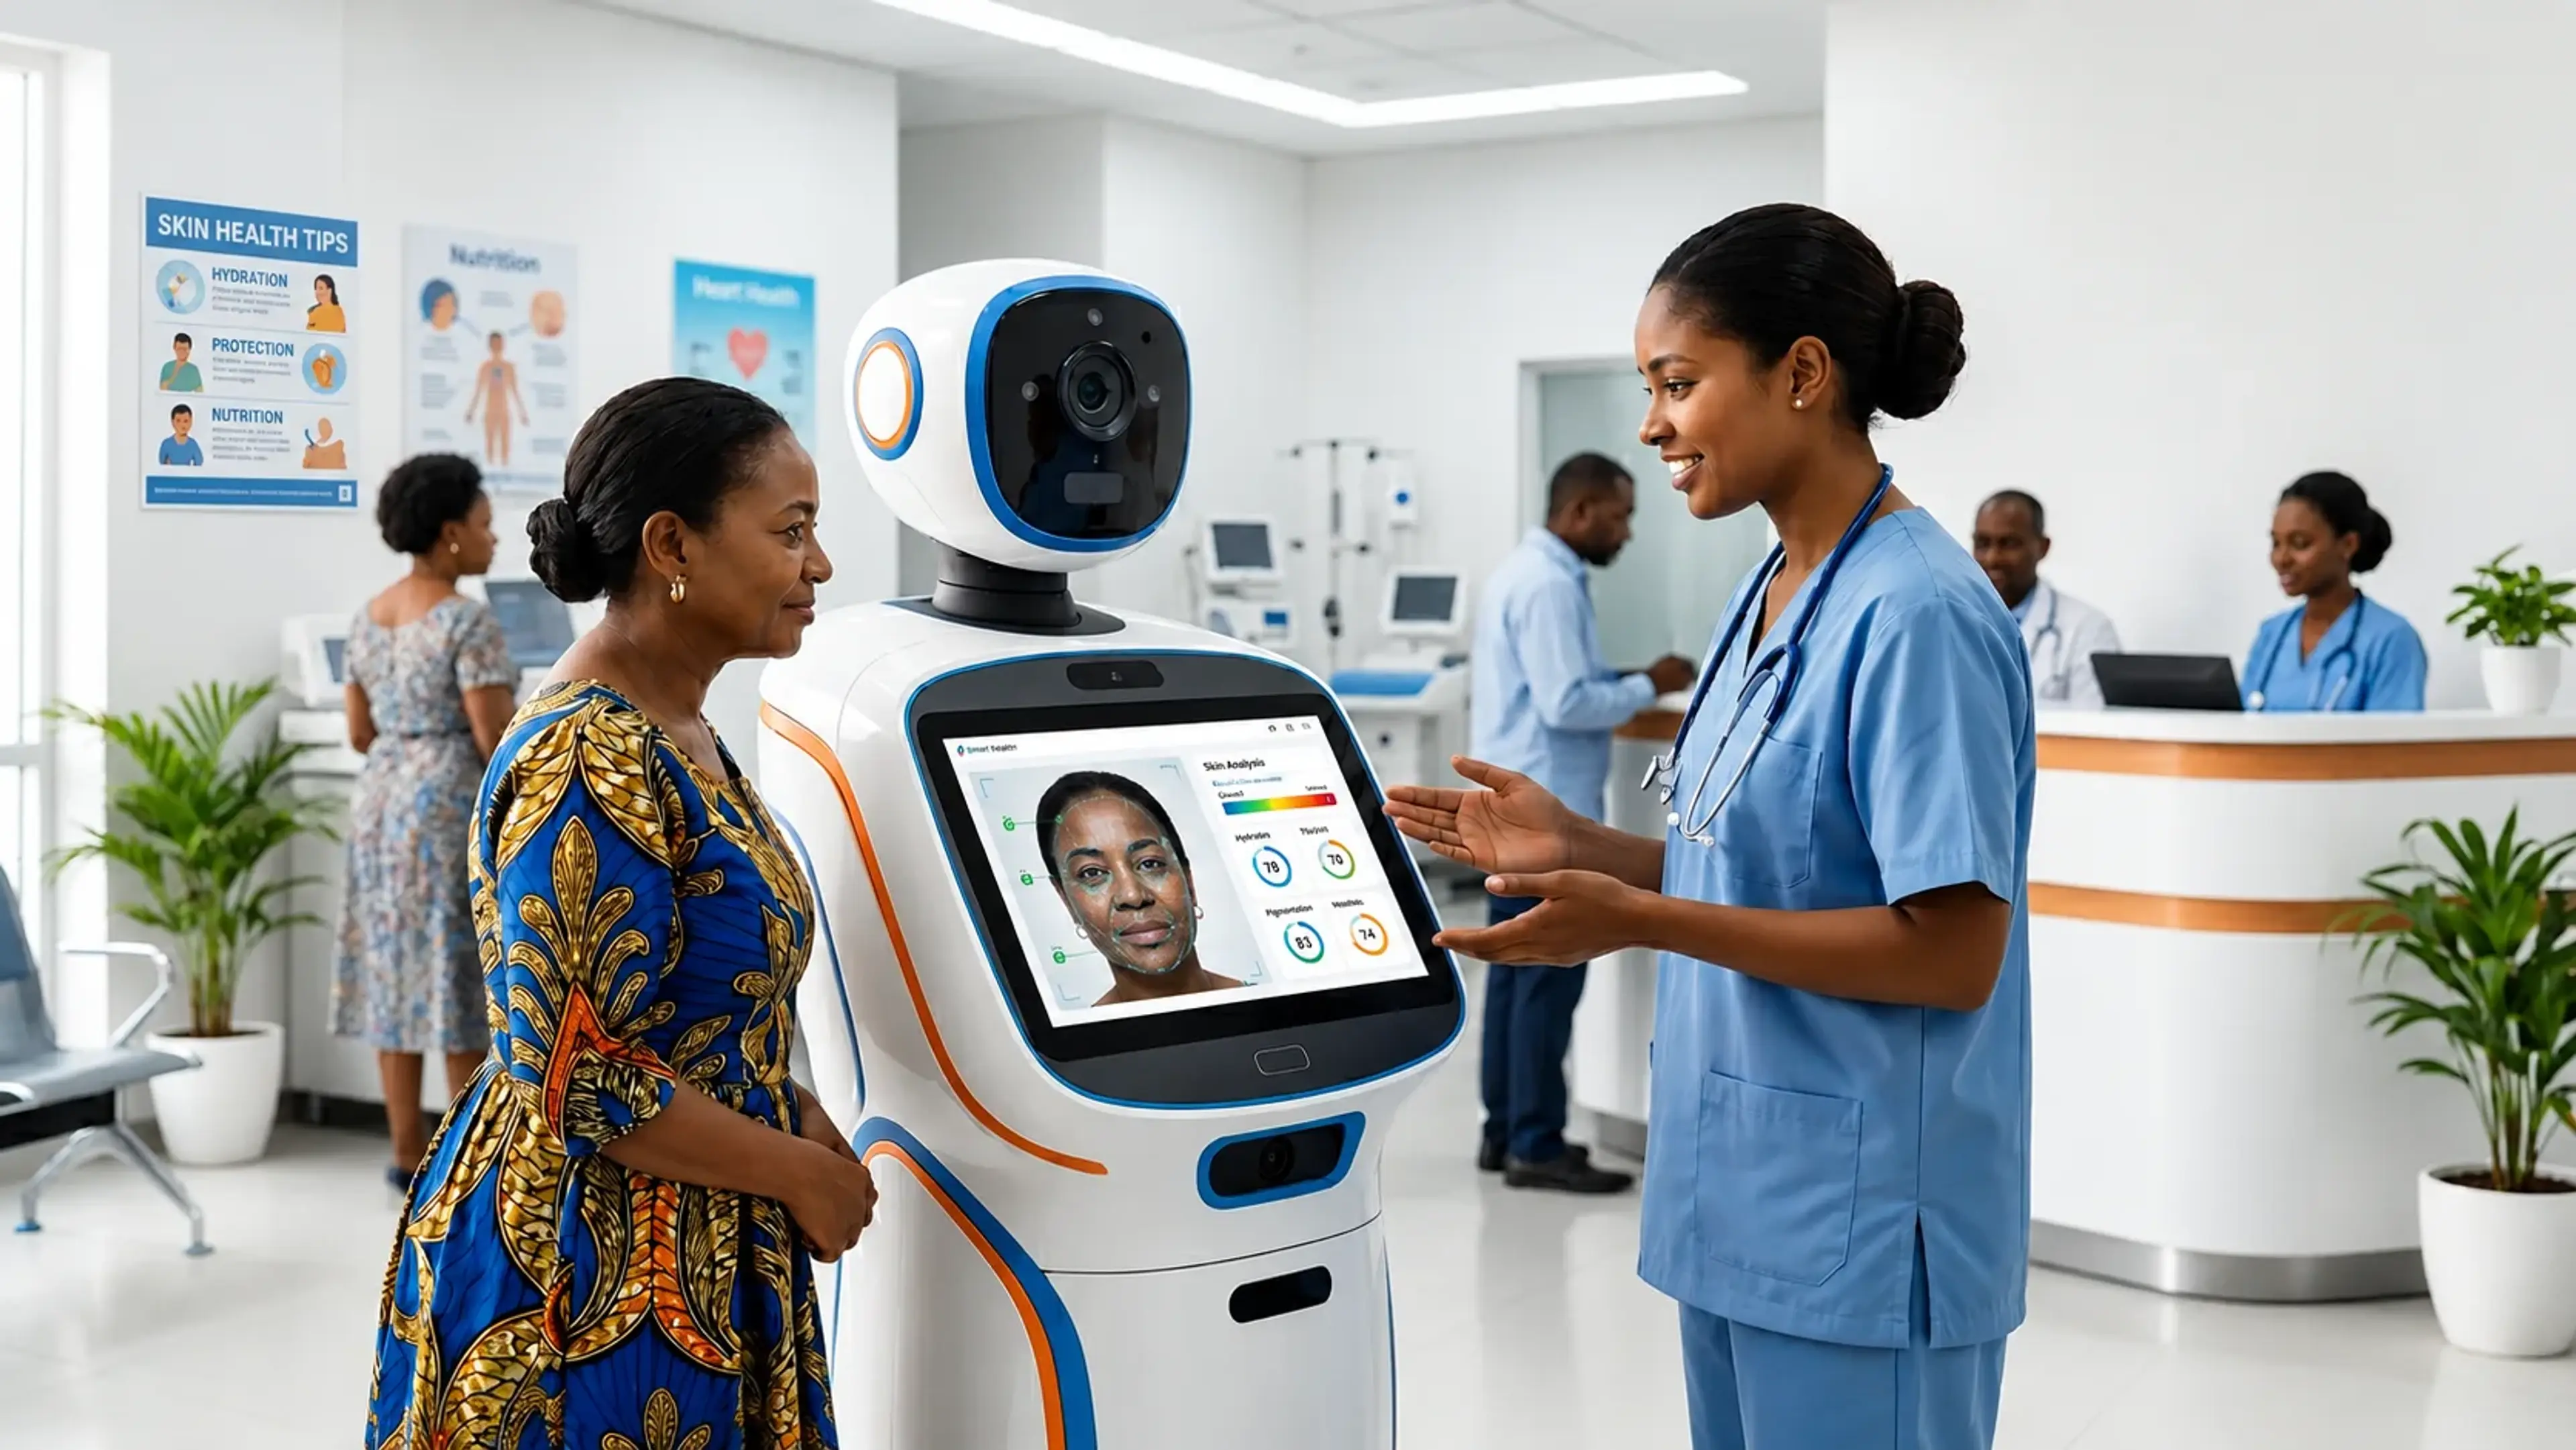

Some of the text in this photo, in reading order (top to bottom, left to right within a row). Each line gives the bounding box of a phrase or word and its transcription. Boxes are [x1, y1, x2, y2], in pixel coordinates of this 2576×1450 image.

[158, 213, 348, 254] SKIN HEALTH TIPS
[449, 242, 541, 276] Nutrition
[212, 266, 288, 288] HYDRATION
[212, 337, 294, 356] PROTECTION
[212, 408, 283, 424] NUTRITION
[1203, 757, 1265, 772] Skin Analysis
[1327, 853, 1344, 866] 70
[1359, 928, 1376, 940] 74
[1295, 936, 1312, 950] 83
